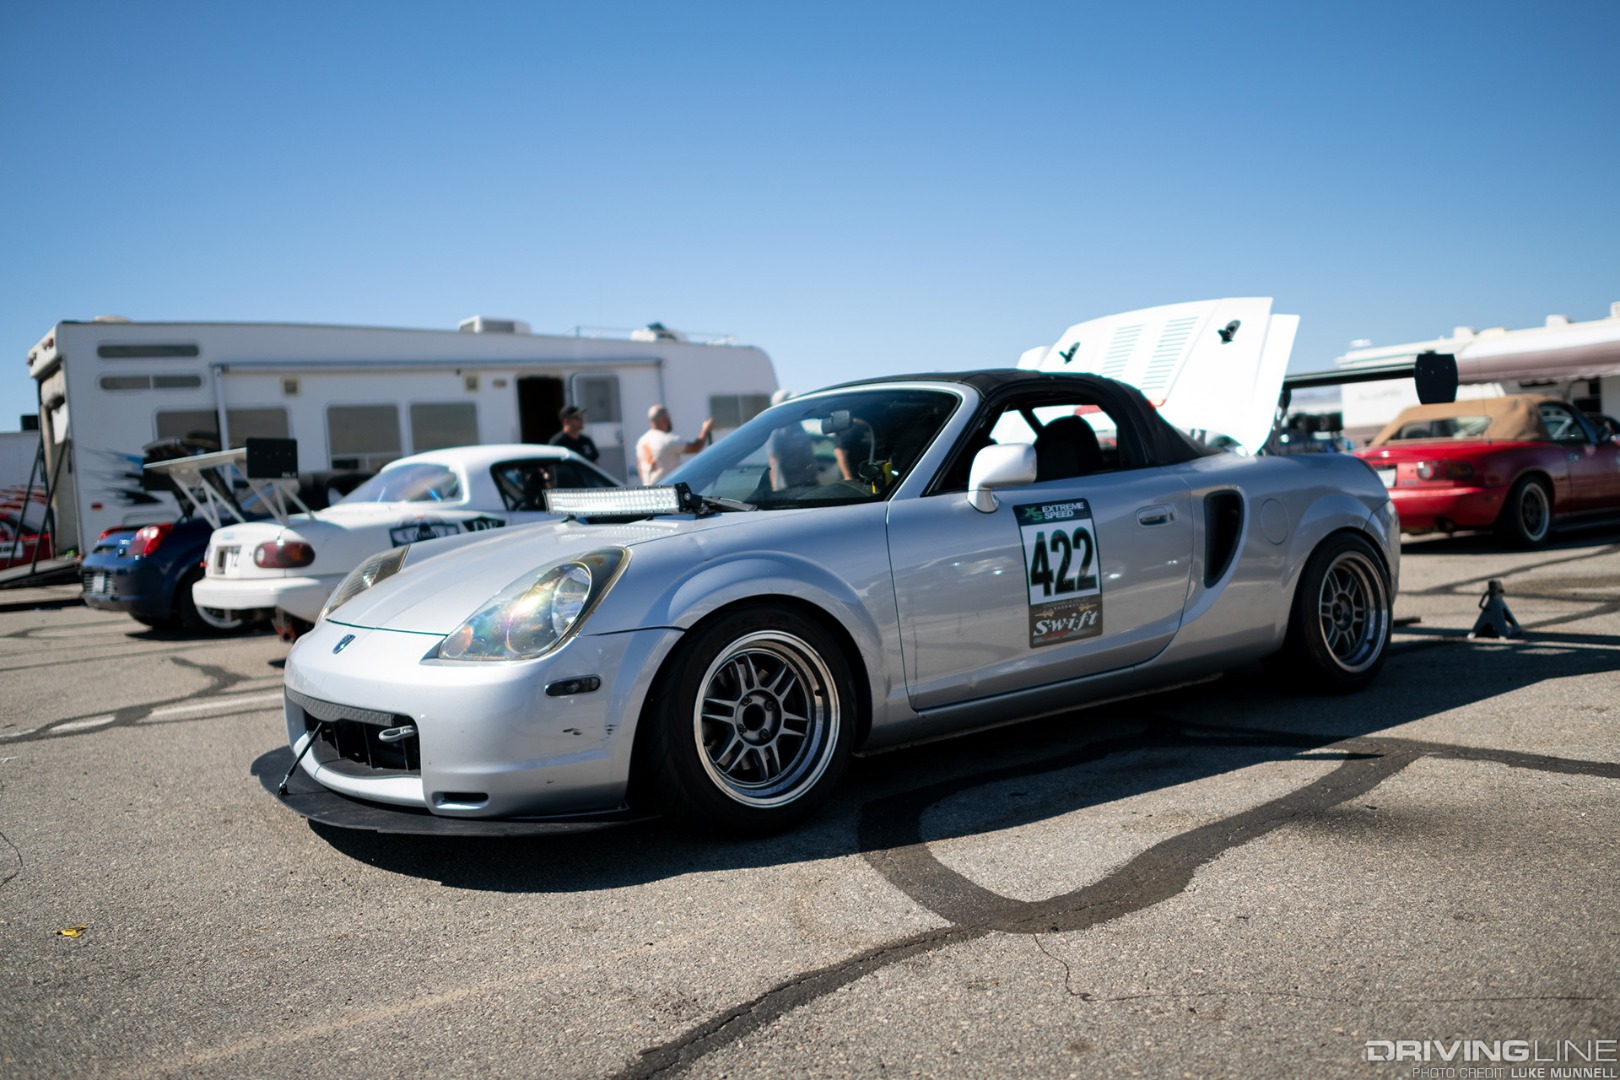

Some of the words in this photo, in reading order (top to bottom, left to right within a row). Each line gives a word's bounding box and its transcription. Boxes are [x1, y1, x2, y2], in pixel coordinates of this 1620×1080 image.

[1042, 502, 1085, 513] EXTREME
[1044, 510, 1074, 519] SPEED
[1030, 526, 1098, 597] 422
